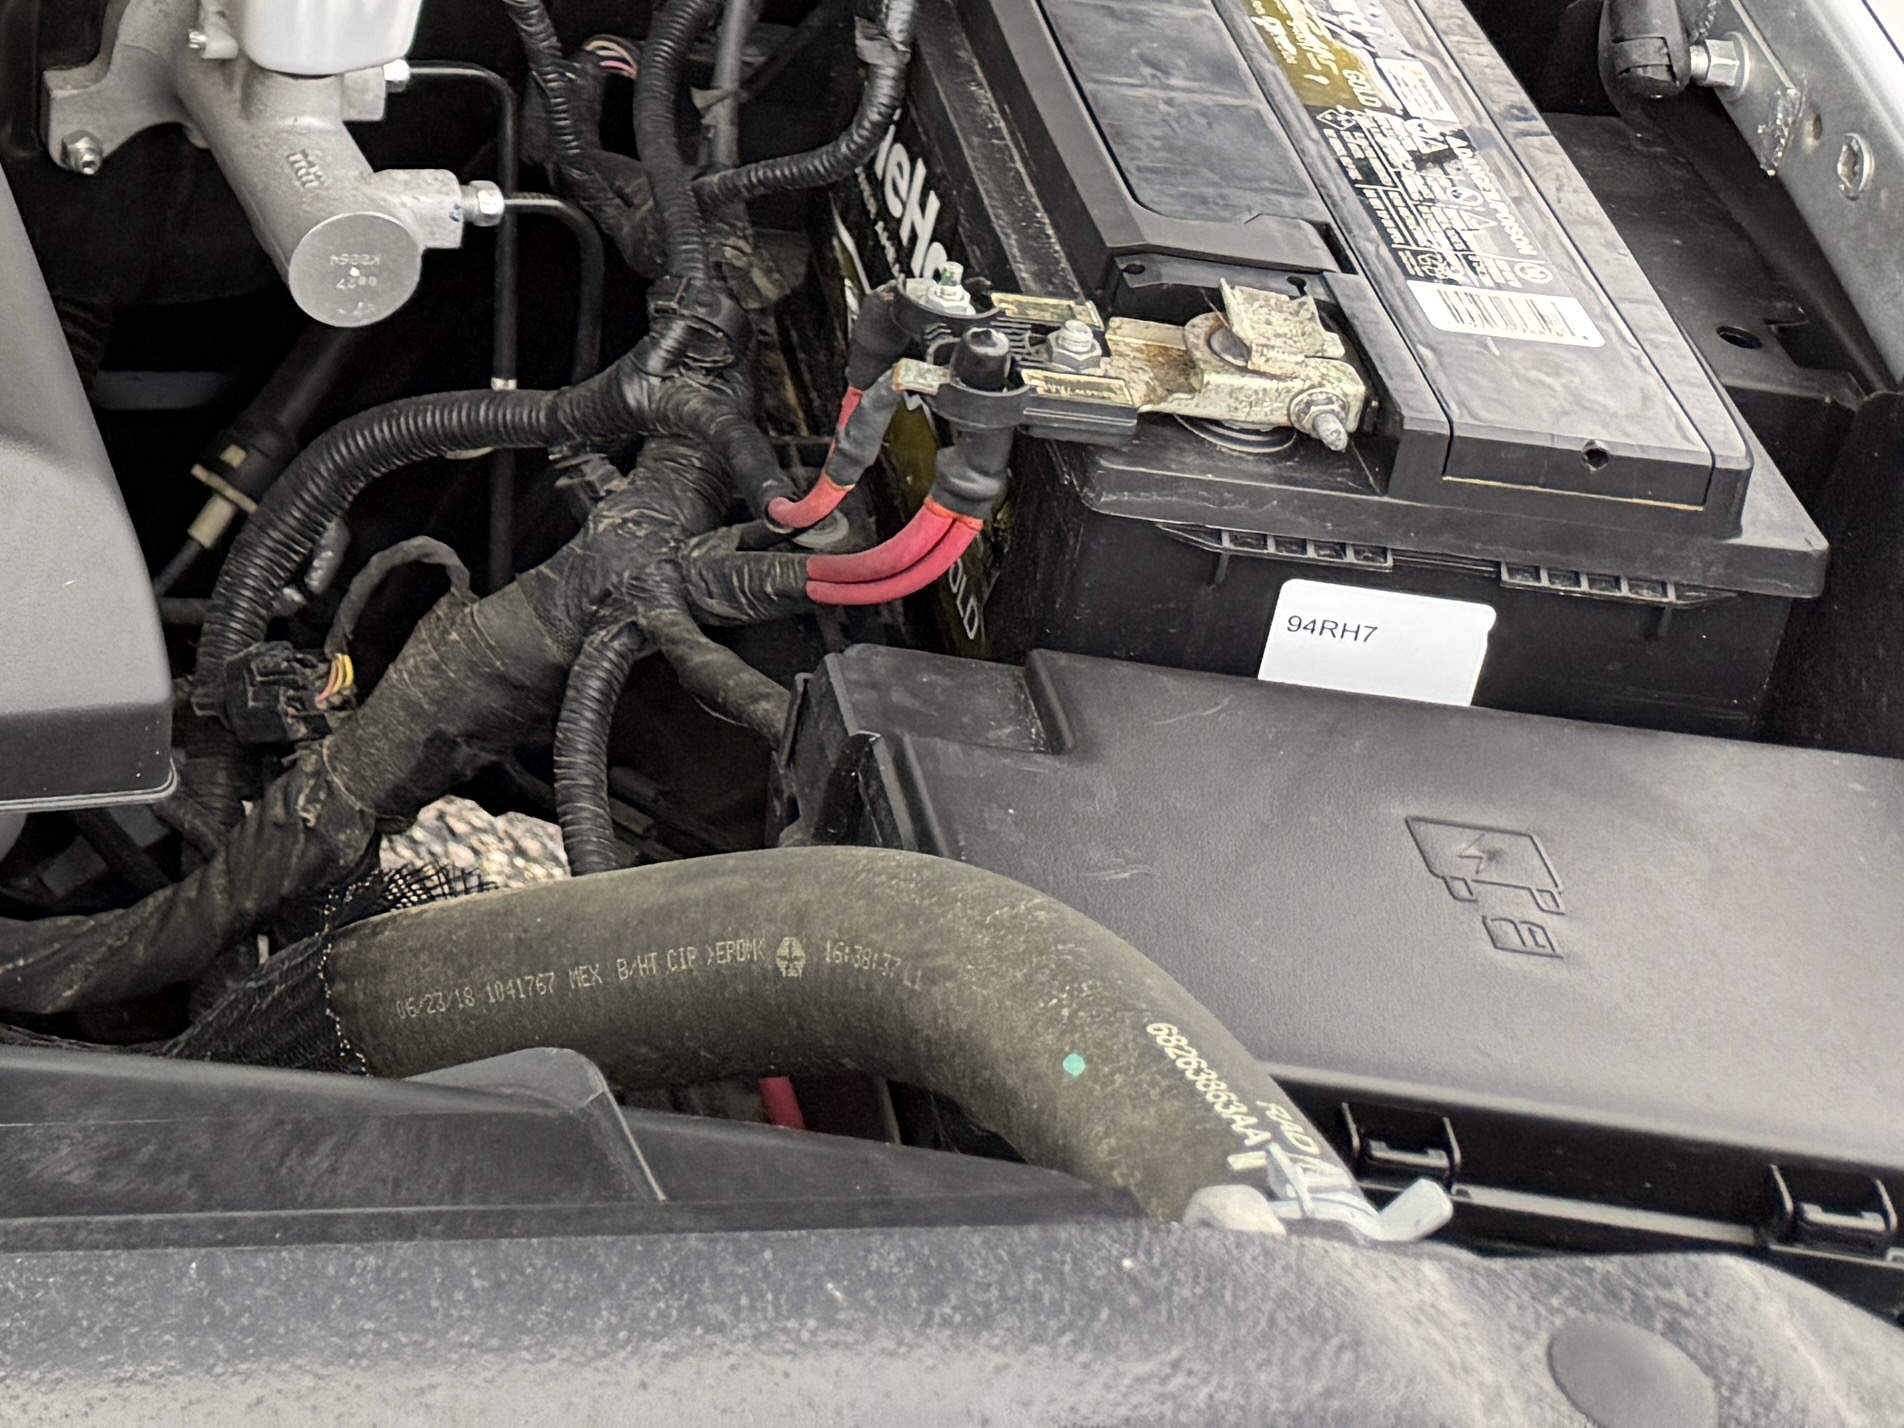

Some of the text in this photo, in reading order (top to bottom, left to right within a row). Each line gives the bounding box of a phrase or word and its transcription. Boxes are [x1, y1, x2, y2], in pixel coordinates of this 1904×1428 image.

[1340, 69, 1383, 107] GOLD
[948, 558, 979, 640] OLD
[1285, 614, 1380, 644] 94RH7
[393, 985, 476, 1020] 06/23/18
[484, 971, 557, 1005] 1041767
[566, 962, 603, 990] MEX
